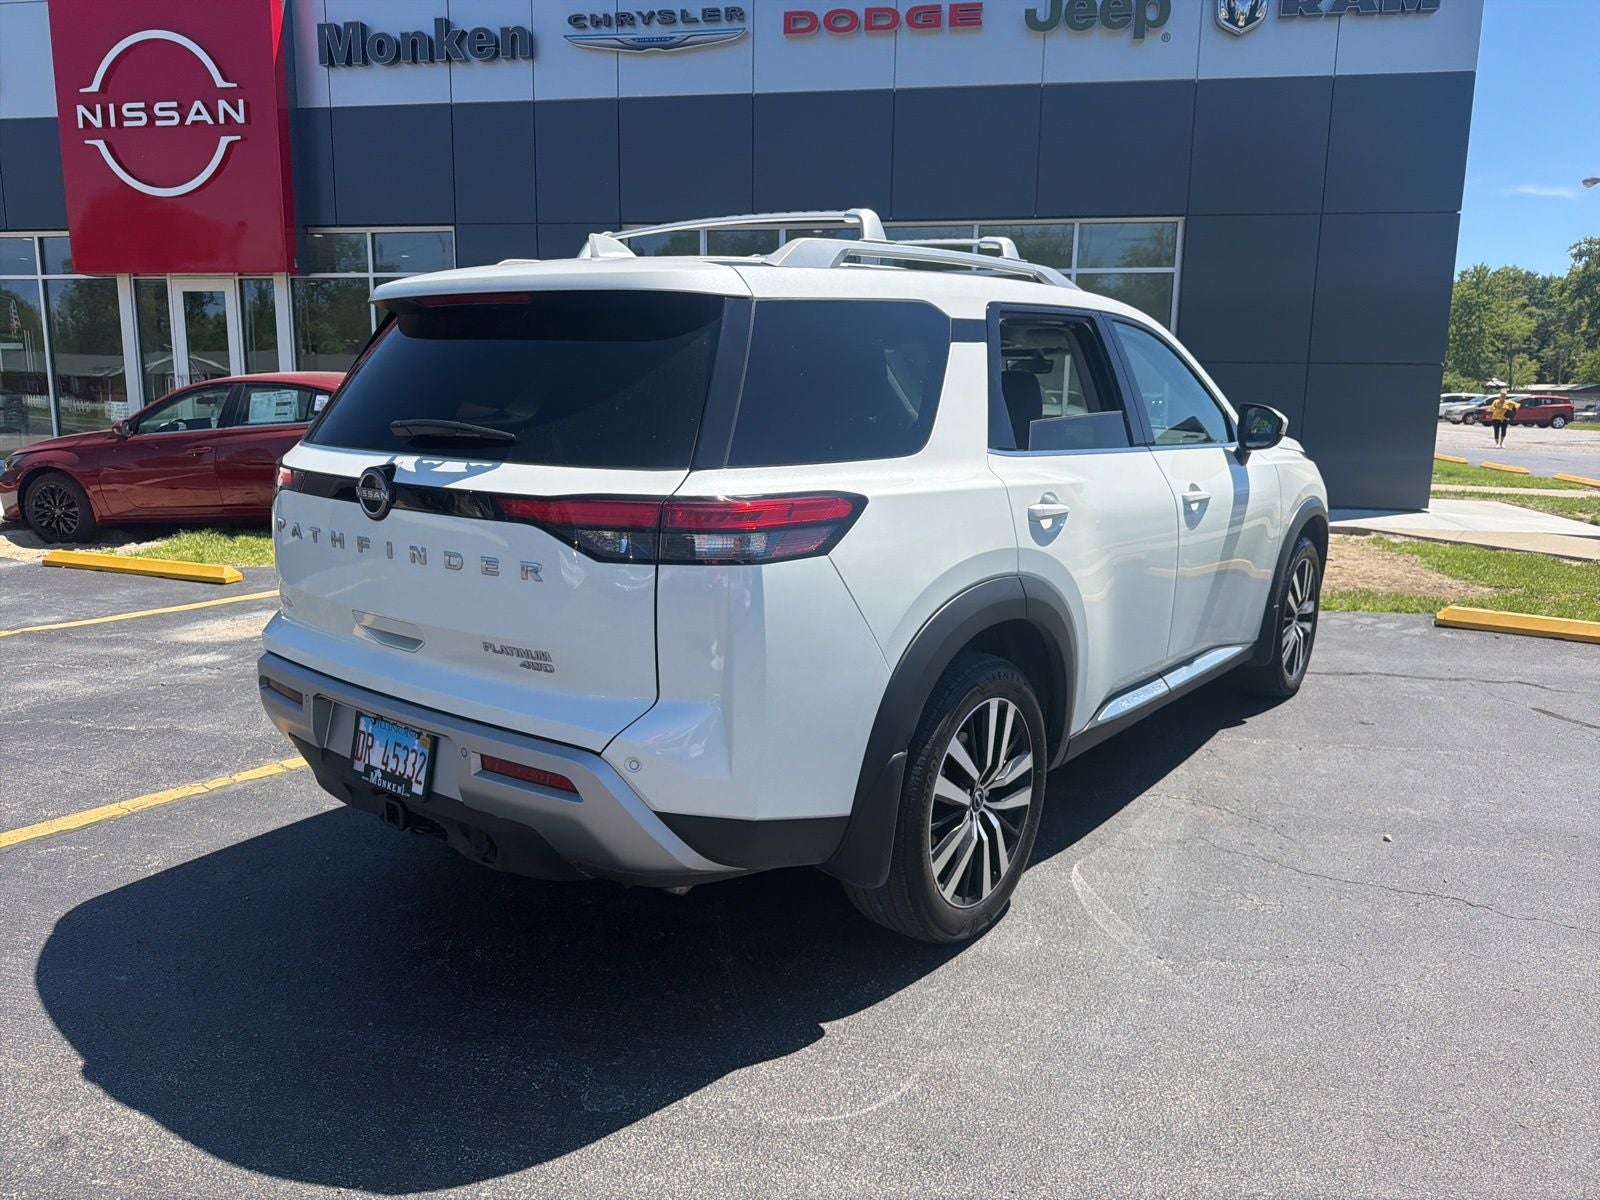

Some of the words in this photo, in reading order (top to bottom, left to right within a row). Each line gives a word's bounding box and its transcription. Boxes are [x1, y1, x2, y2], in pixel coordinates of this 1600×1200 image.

[567, 6, 745, 29] CHRYSLER
[783, 2, 984, 36] DODGE
[1024, 0, 1172, 40] Jeep
[316, 16, 532, 67] Monken
[76, 98, 246, 129] NISSAN
[356, 486, 390, 501] NISSAN
[276, 517, 544, 583] PATHFINDER
[482, 641, 553, 663] PLATINUM
[519, 660, 555, 674] 4WD
[355, 730, 375, 766] DR
[381, 739, 427, 786] 45332
